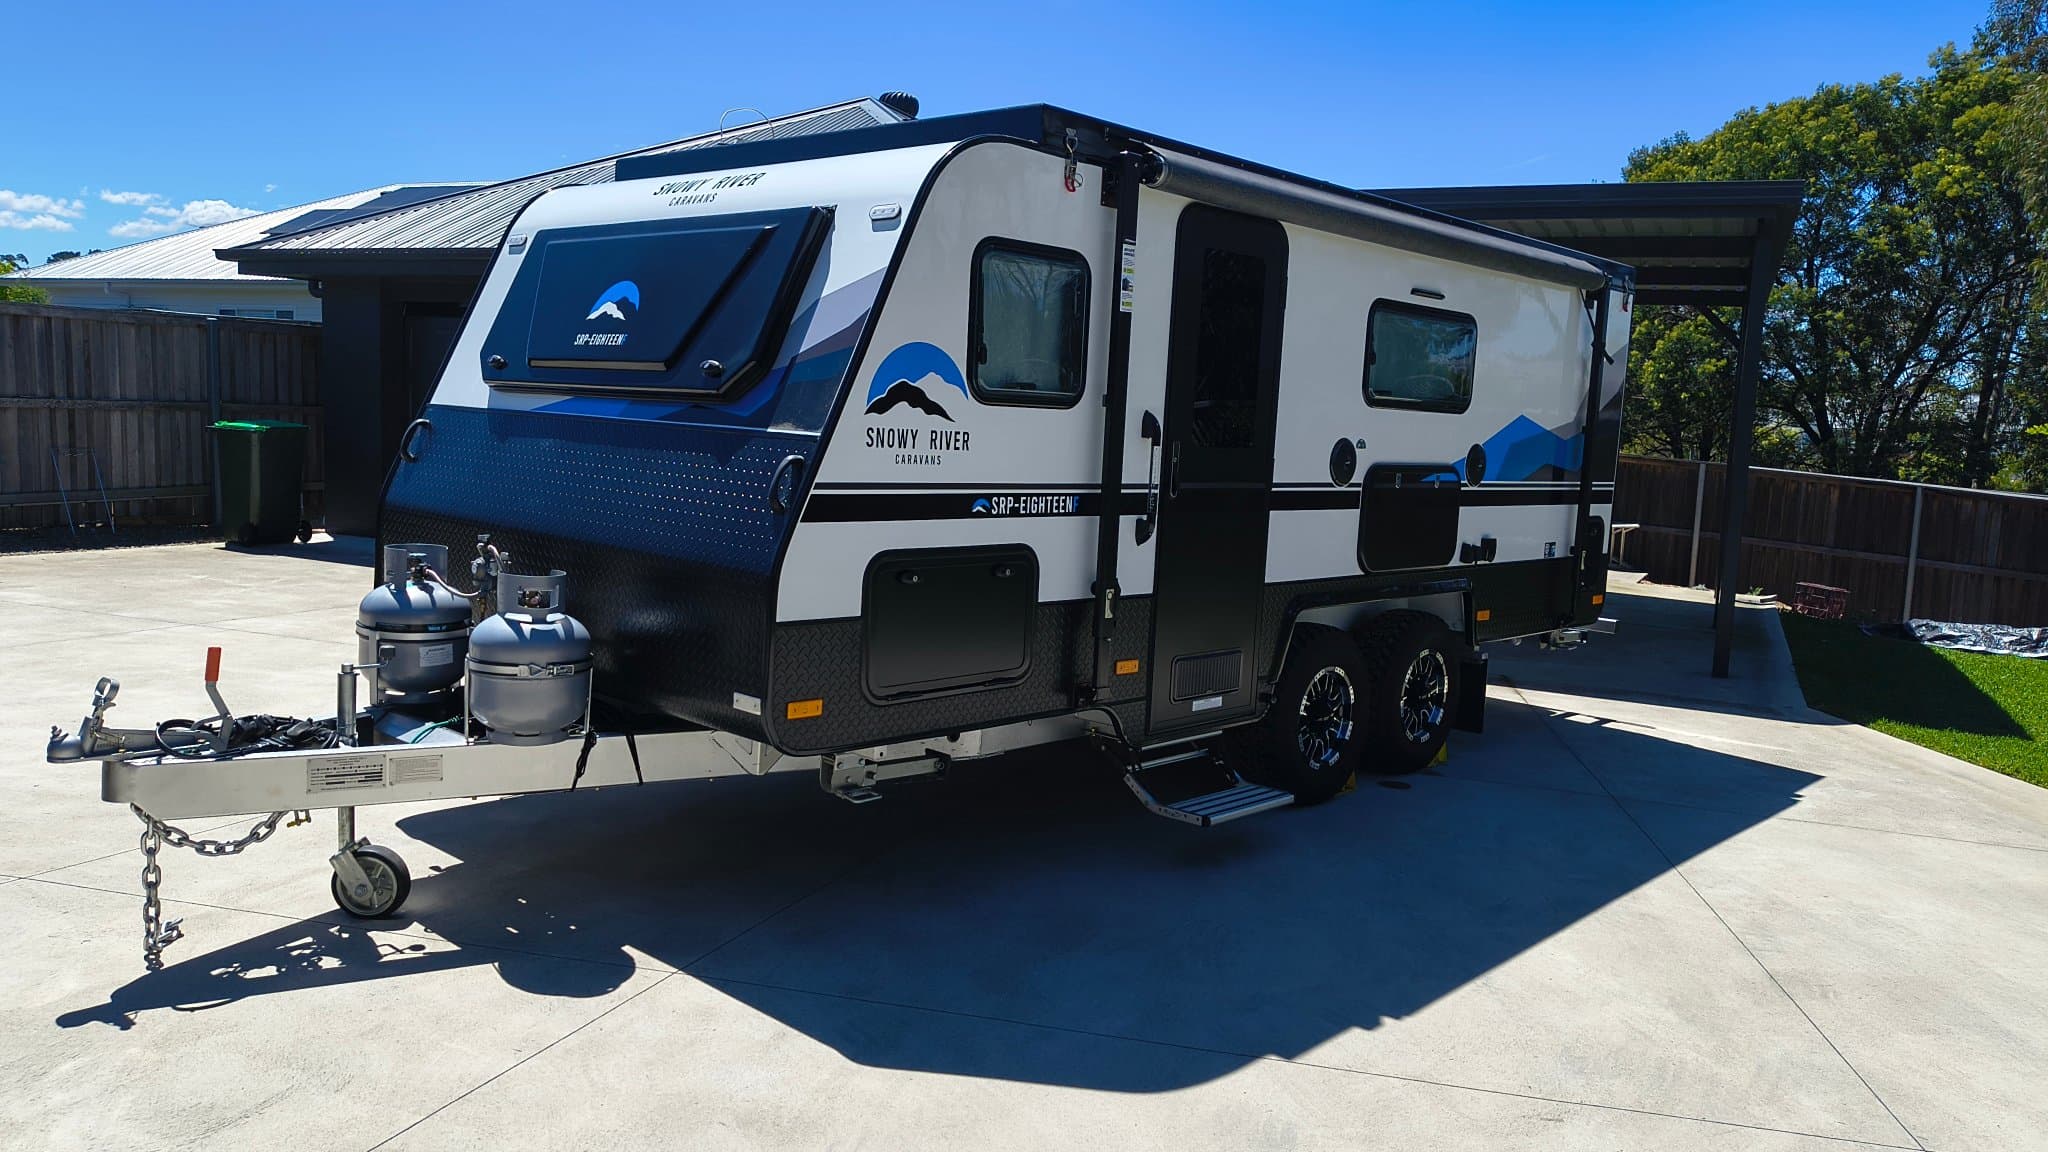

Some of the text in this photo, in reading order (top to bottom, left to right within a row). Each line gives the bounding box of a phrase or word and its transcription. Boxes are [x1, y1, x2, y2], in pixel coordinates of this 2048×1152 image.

[653, 172, 767, 196] SNOWY RIVER
[668, 193, 718, 207] CARAVANS
[866, 427, 970, 451] SNOWY RIVER
[895, 453, 941, 465] CARAVANS
